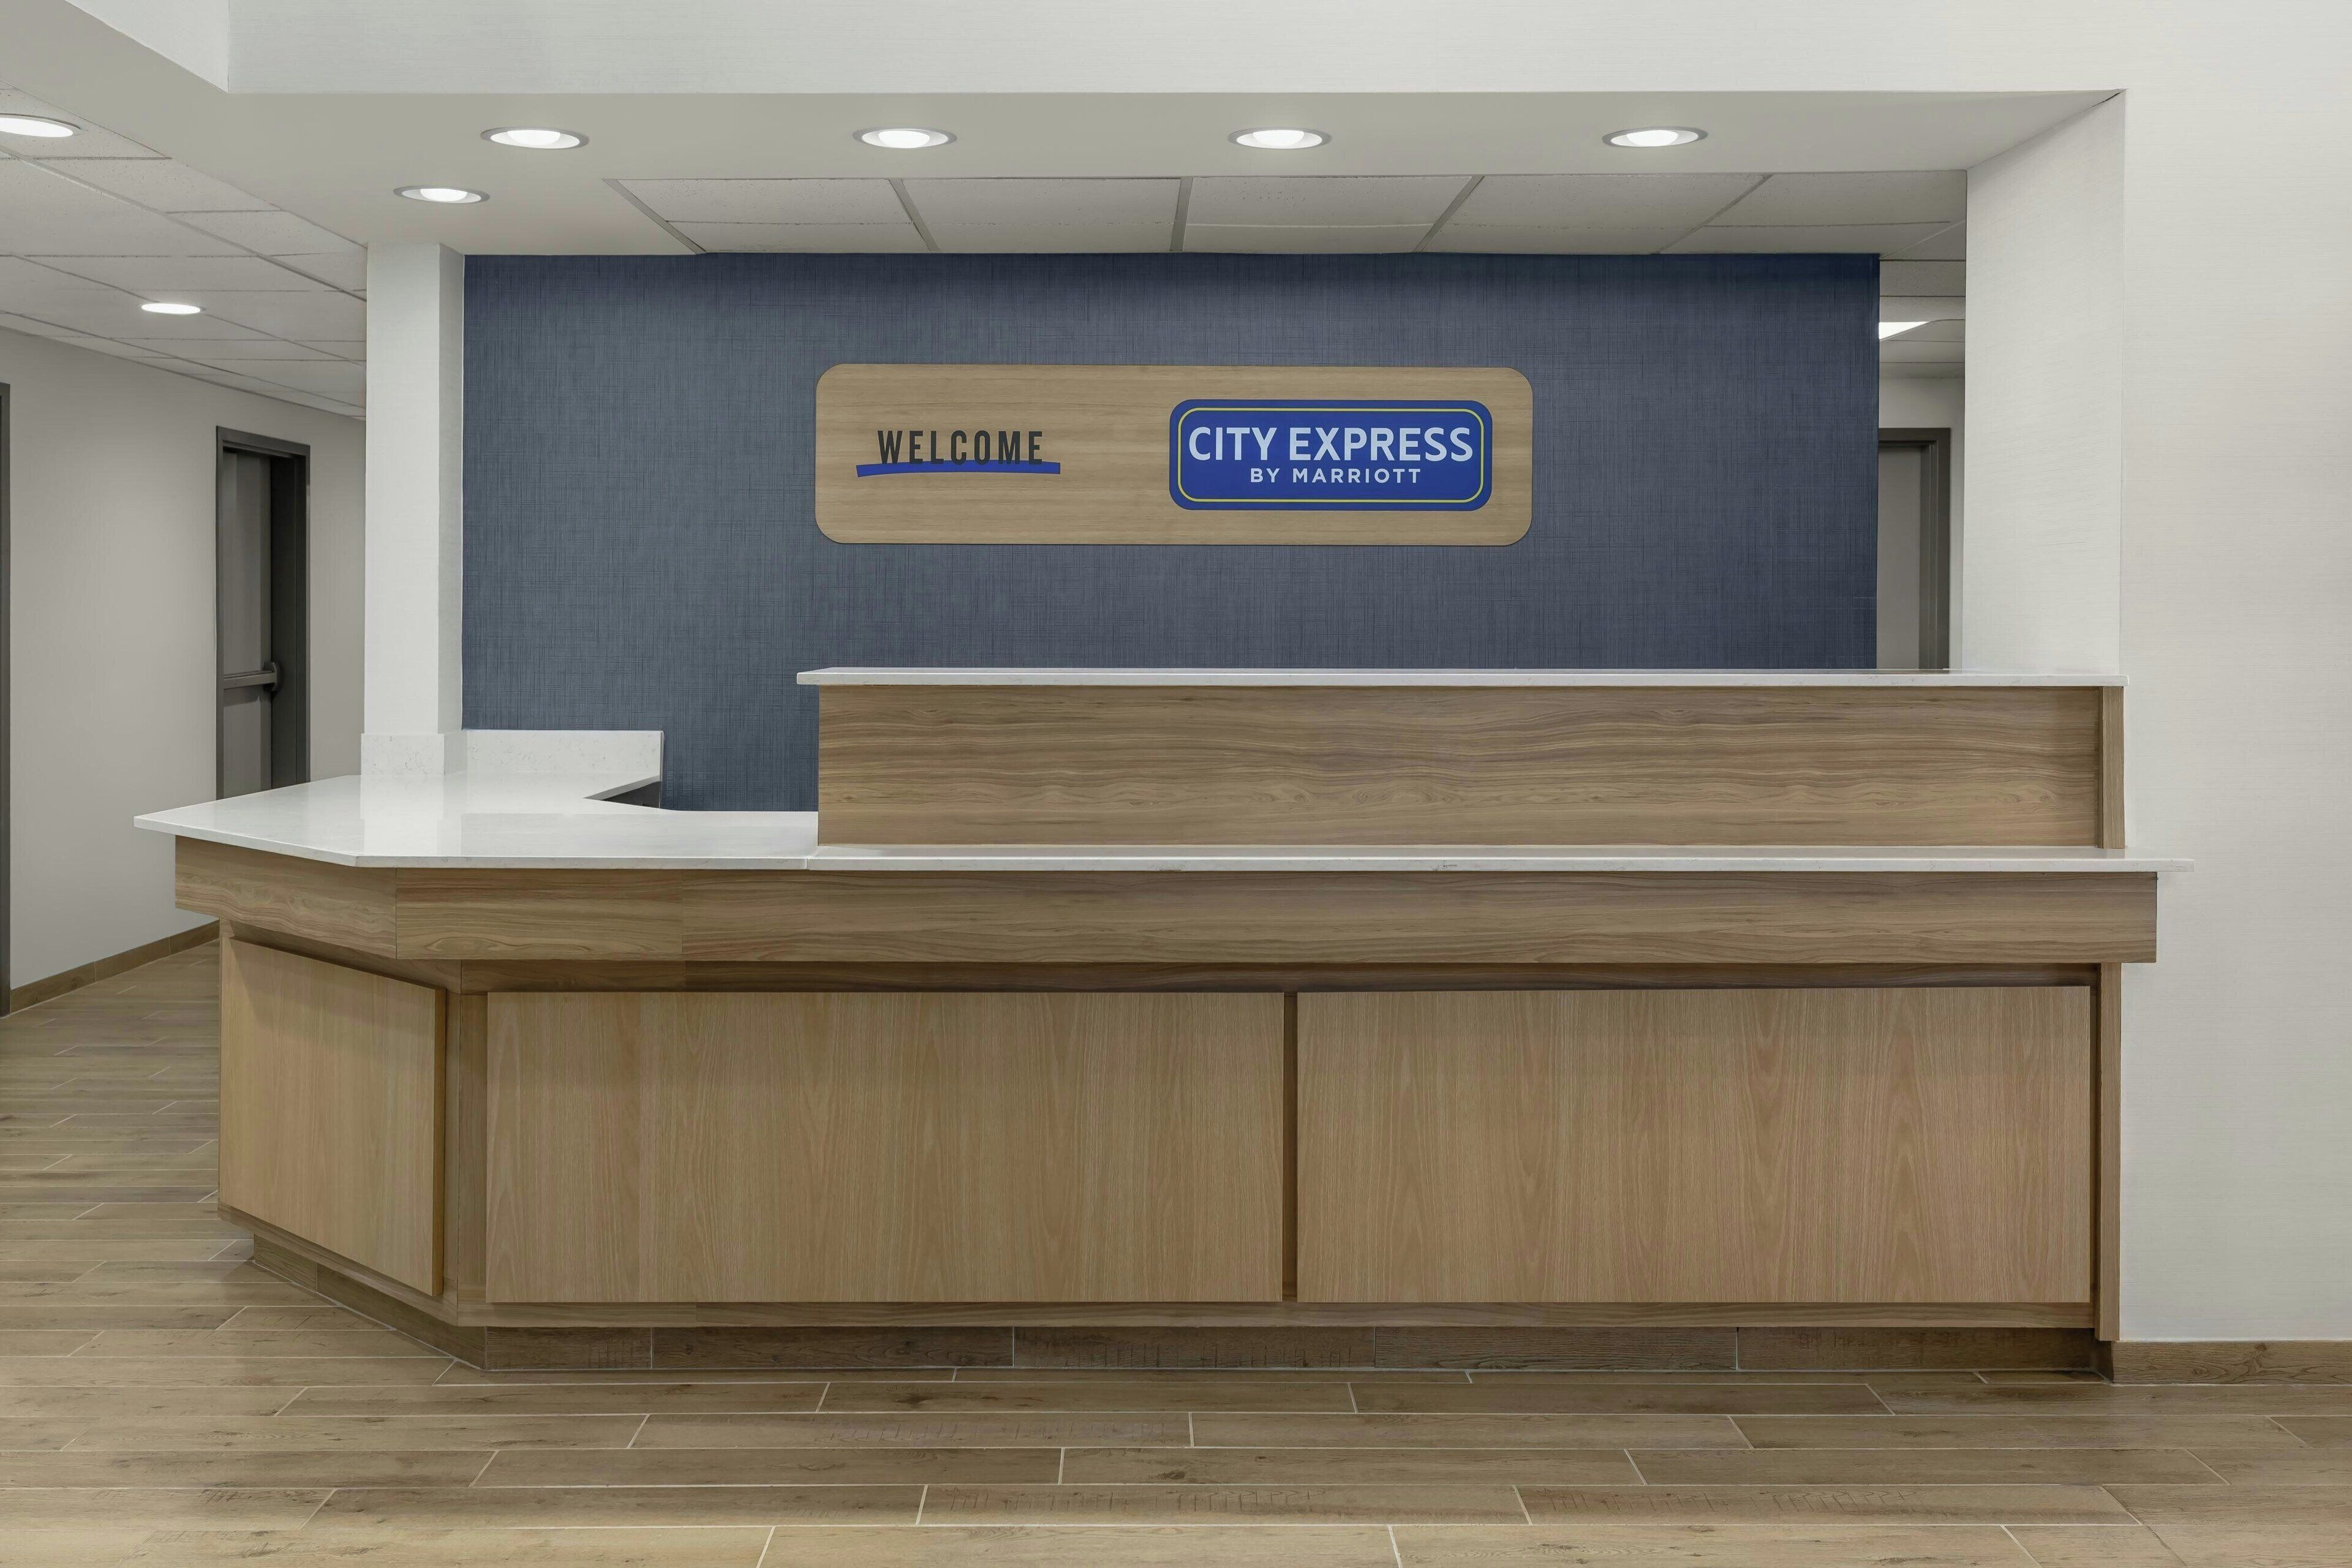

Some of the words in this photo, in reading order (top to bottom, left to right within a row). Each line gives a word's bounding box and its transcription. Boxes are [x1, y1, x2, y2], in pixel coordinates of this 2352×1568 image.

[877, 430, 1043, 465] WELCOME
[1189, 426, 1277, 461] CITY
[1289, 427, 1473, 462] EXPRESS
[1250, 468, 1280, 483] BY
[1292, 468, 1421, 483] MARRIOTT
